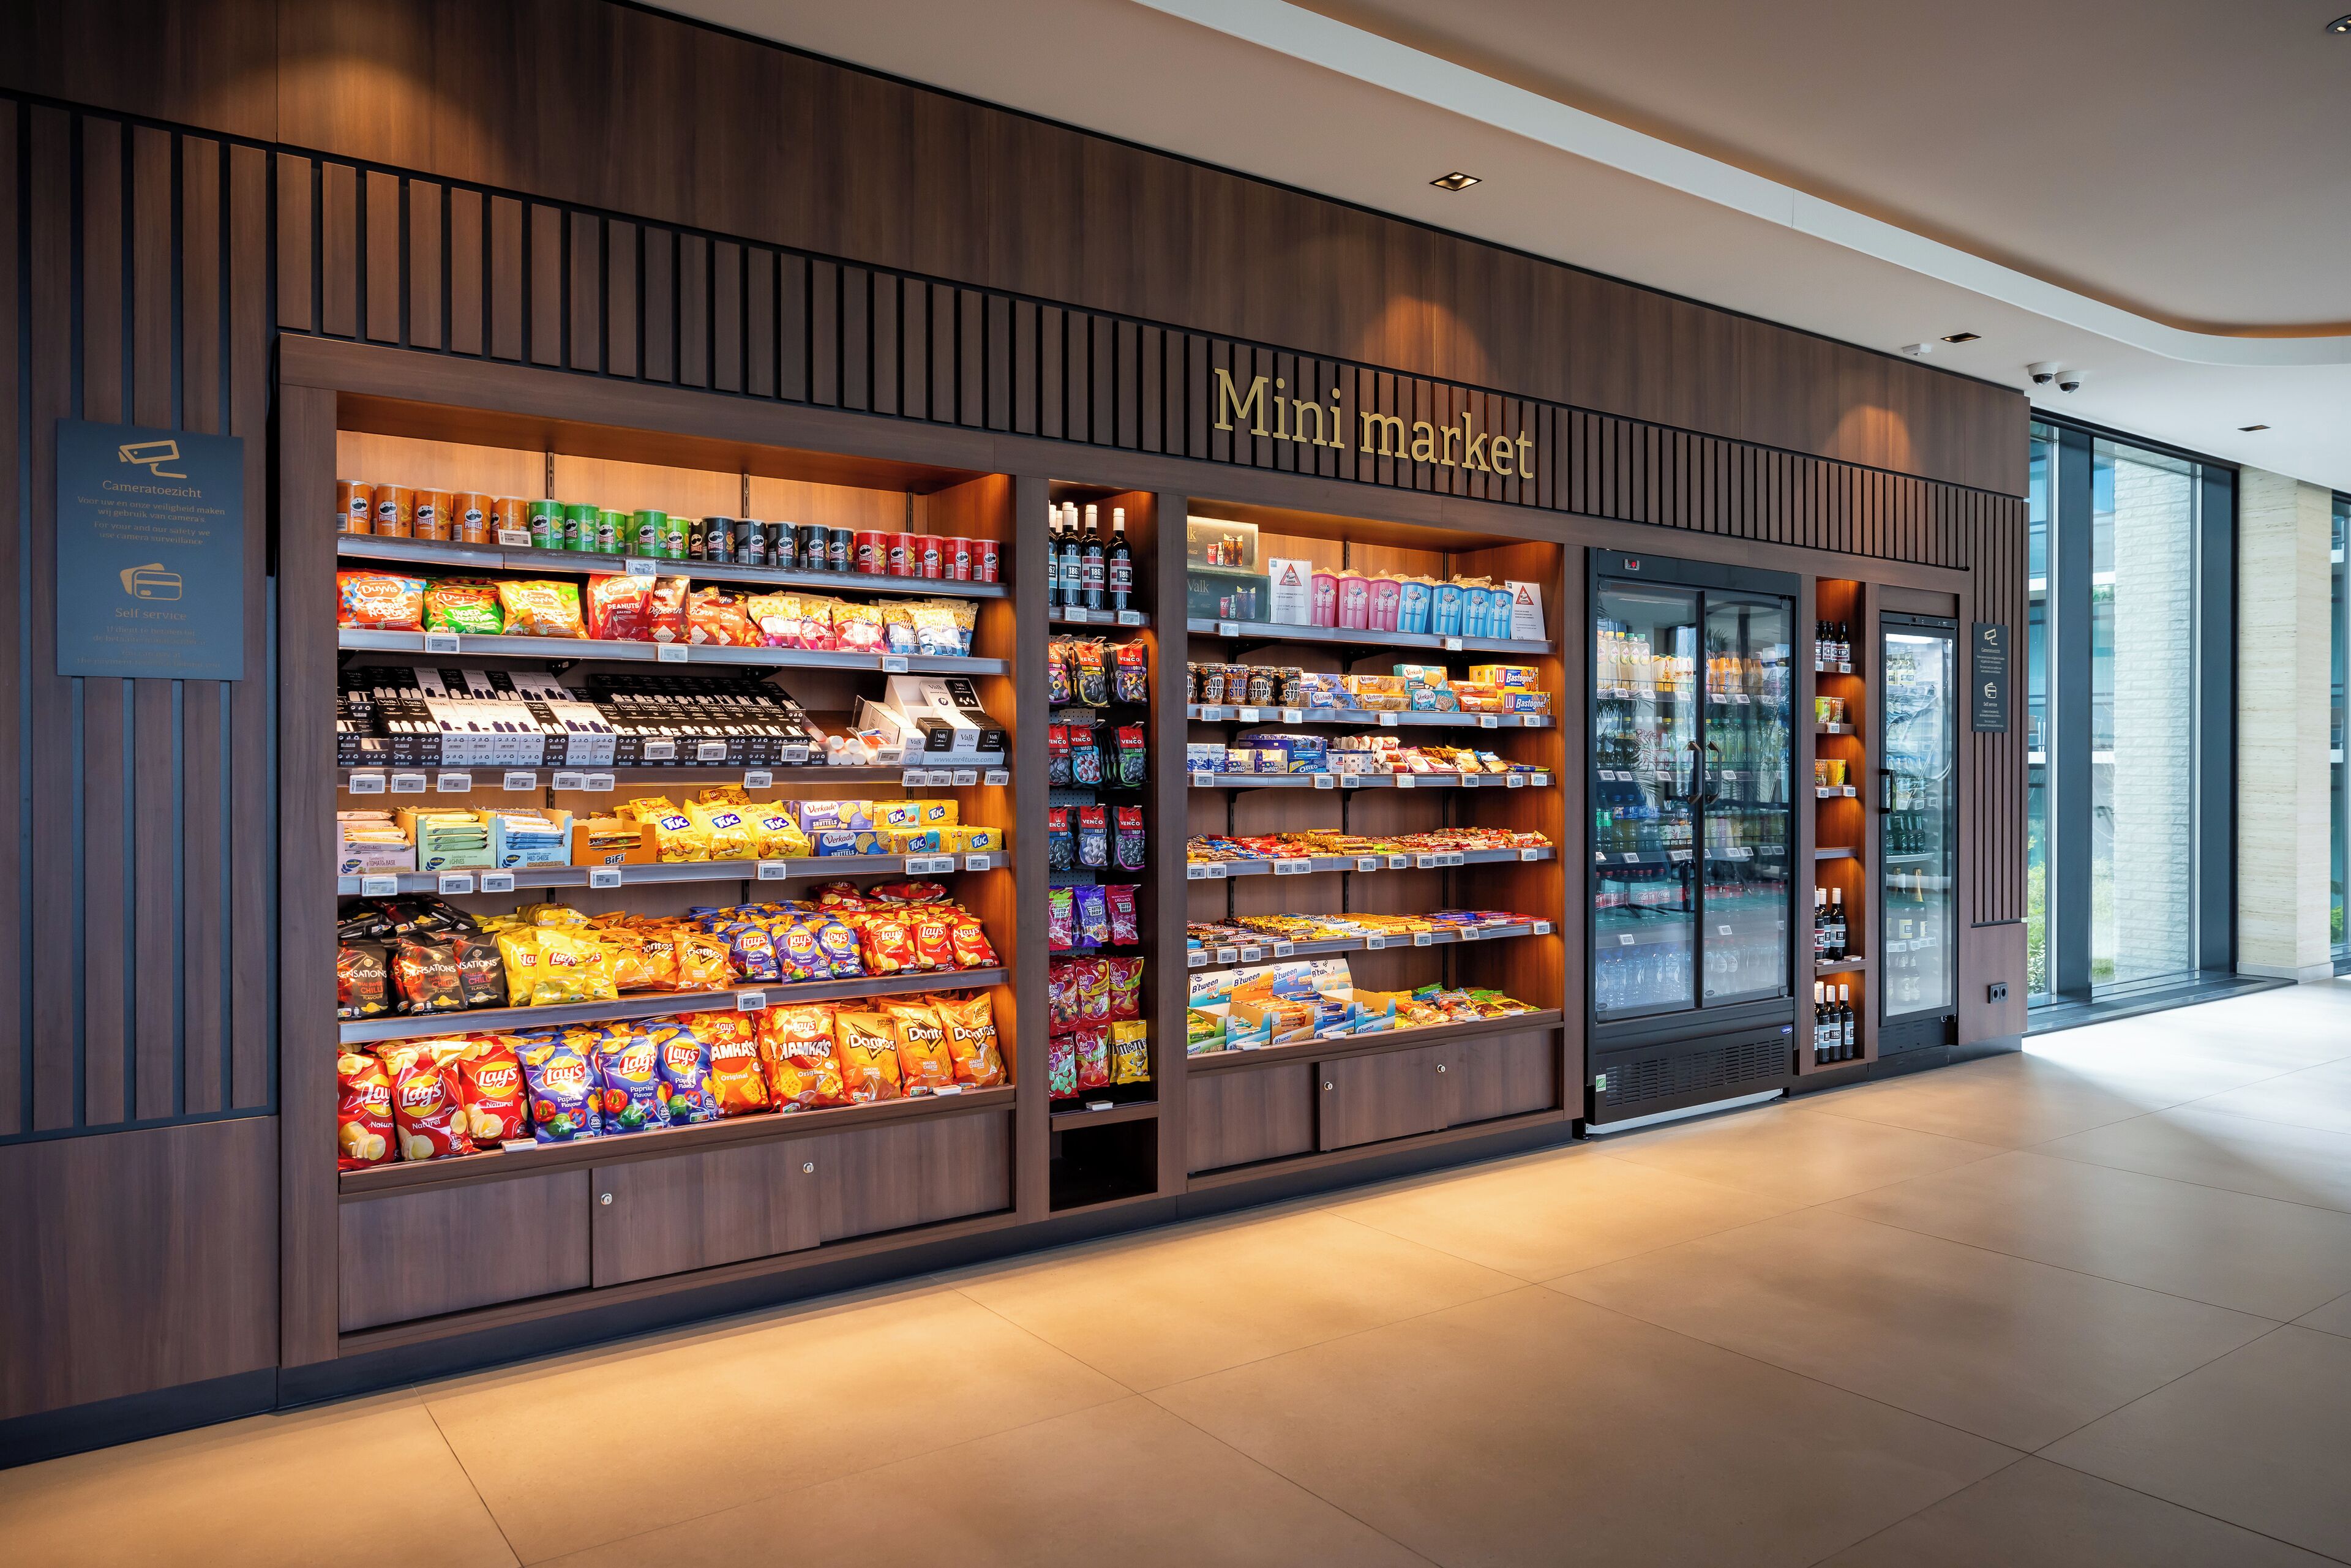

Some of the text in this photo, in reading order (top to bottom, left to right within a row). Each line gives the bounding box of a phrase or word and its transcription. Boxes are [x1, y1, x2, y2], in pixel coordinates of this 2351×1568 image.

[1214, 368, 1534, 479] Mini market
[102, 480, 201, 498] Cameratoezicht
[78, 496, 99, 505] Voor
[153, 503, 194, 512] veiligheid
[113, 510, 147, 519] gebruik
[350, 510, 367, 519] PRINGLES
[379, 514, 397, 523] PRINGLES
[170, 528, 196, 536] safety
[362, 585, 397, 595] Duyvis
[608, 582, 636, 593] Duyvis
[1187, 579, 1210, 593] Valk
[1314, 594, 1333, 602] POPCORN
[1344, 596, 1365, 604] POPCORN
[1374, 598, 1396, 607] POPCORN
[1401, 601, 1423, 610] POPCORN
[115, 607, 186, 620] Self service
[1210, 678, 1223, 687] NON
[1232, 678, 1245, 688] NON
[1496, 670, 1504, 684] LU
[1506, 673, 1534, 683] Bastogne!
[1250, 681, 1267, 689] NON
[1249, 689, 1269, 697] STOP!
[1505, 695, 1514, 708] LU
[1516, 697, 1546, 708] Bastogne!
[808, 803, 837, 813] Verkade
[929, 808, 944, 819] TUC
[662, 817, 689, 830] TUC
[714, 814, 740, 827] TUC
[766, 817, 788, 829] TUC
[889, 812, 905, 823] TUC
[825, 833, 854, 844] Verkade
[909, 838, 925, 850] TUC
[972, 835, 988, 847] TUC
[605, 854, 624, 864] BiFi
[881, 929, 904, 940] Lay's
[921, 925, 944, 938] Lay's
[960, 925, 980, 937] Lay's
[741, 935, 767, 949] Lay's
[337, 970, 386, 978] SENSATIONS
[1234, 972, 1260, 987] B'tween
[1273, 968, 1297, 981] B'tween
[1193, 979, 1218, 993] B'tween
[973, 1003, 990, 1015] BOLDER
[716, 1021, 735, 1033] Lay's
[954, 1024, 996, 1040] Doritos
[1359, 1025, 1374, 1033] B'tween
[850, 1034, 896, 1050] Doritos
[1275, 1035, 1292, 1044] B'tween
[779, 1040, 831, 1060] HAMKA'S
[668, 1047, 699, 1067] Lay's
[622, 1054, 655, 1076] Lay's
[479, 1066, 517, 1087] Lay's
[546, 1064, 584, 1084] Lay's
[721, 1073, 748, 1081] Original
[403, 1074, 441, 1107] Lay's
[630, 1085, 654, 1093] Paprika
[413, 1118, 440, 1130] Naturel
